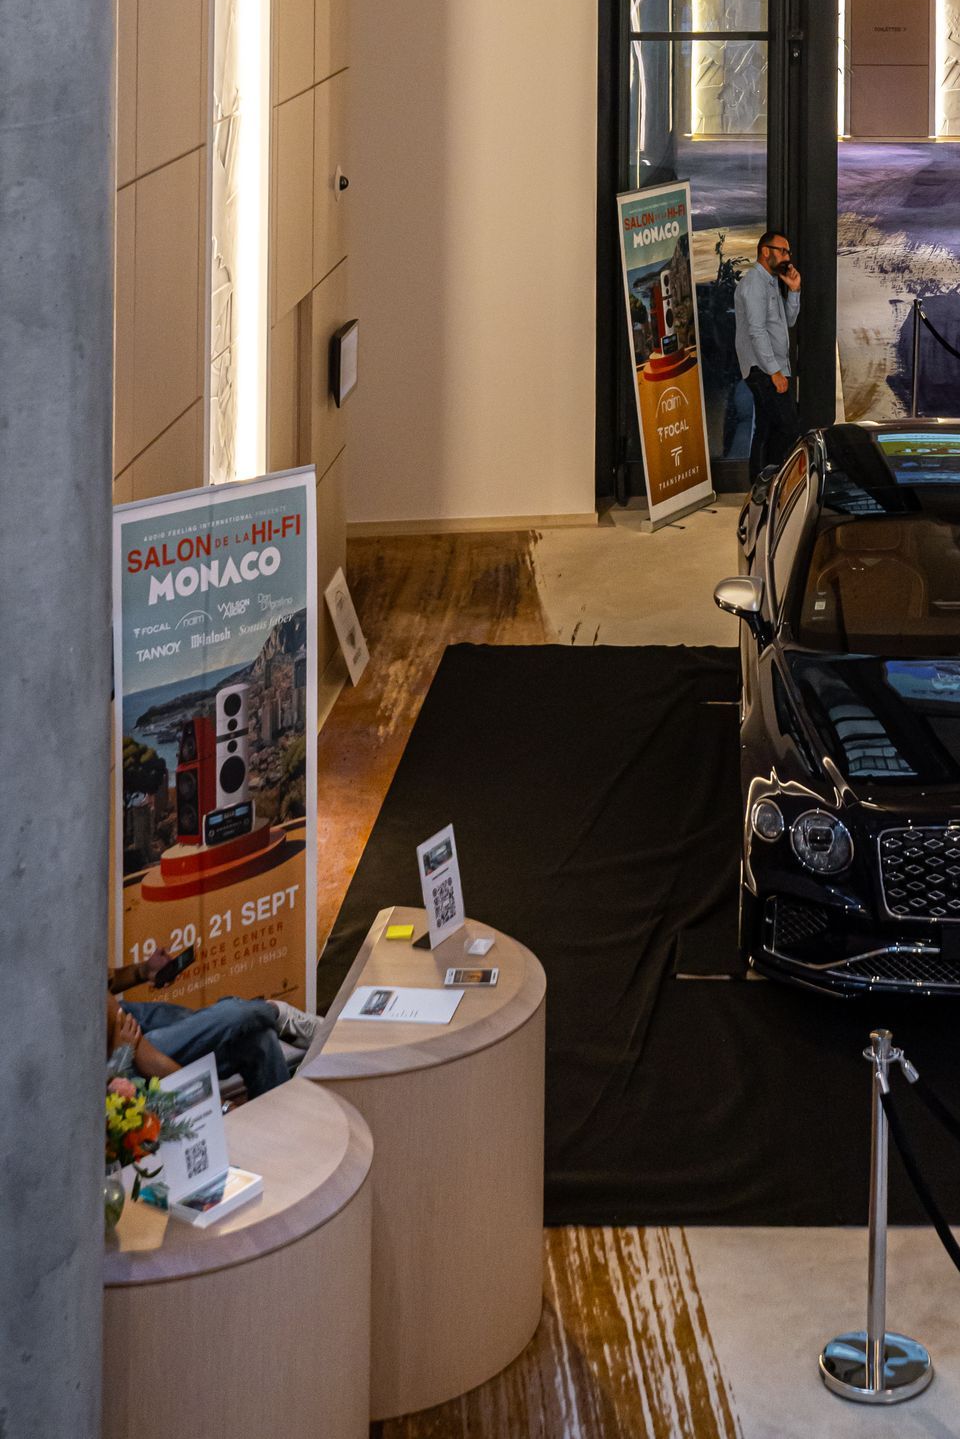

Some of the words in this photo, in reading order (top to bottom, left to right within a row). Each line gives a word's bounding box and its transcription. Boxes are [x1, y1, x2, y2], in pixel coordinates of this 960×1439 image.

[623, 211, 655, 231] SALON
[633, 221, 680, 248] MONACO
[664, 418, 689, 439] FOCAL
[659, 466, 699, 490] TRANSPARENT
[143, 532, 165, 542] AUDIO
[168, 524, 198, 537] FEELING
[200, 513, 252, 529] INTERNATIONAL
[127, 533, 211, 574] SALON
[215, 535, 229, 549] DE
[235, 534, 249, 545] LA
[252, 514, 301, 545] HI-FI
[148, 546, 281, 605] MONACO
[141, 622, 171, 636] FOCAL
[136, 640, 182, 663] TANNOY
[169, 923, 202, 953] 20,
[209, 910, 232, 939] 21
[241, 884, 300, 926] SEPT
[233, 921, 284, 948] CENTER
[234, 937, 278, 960] CARLO
